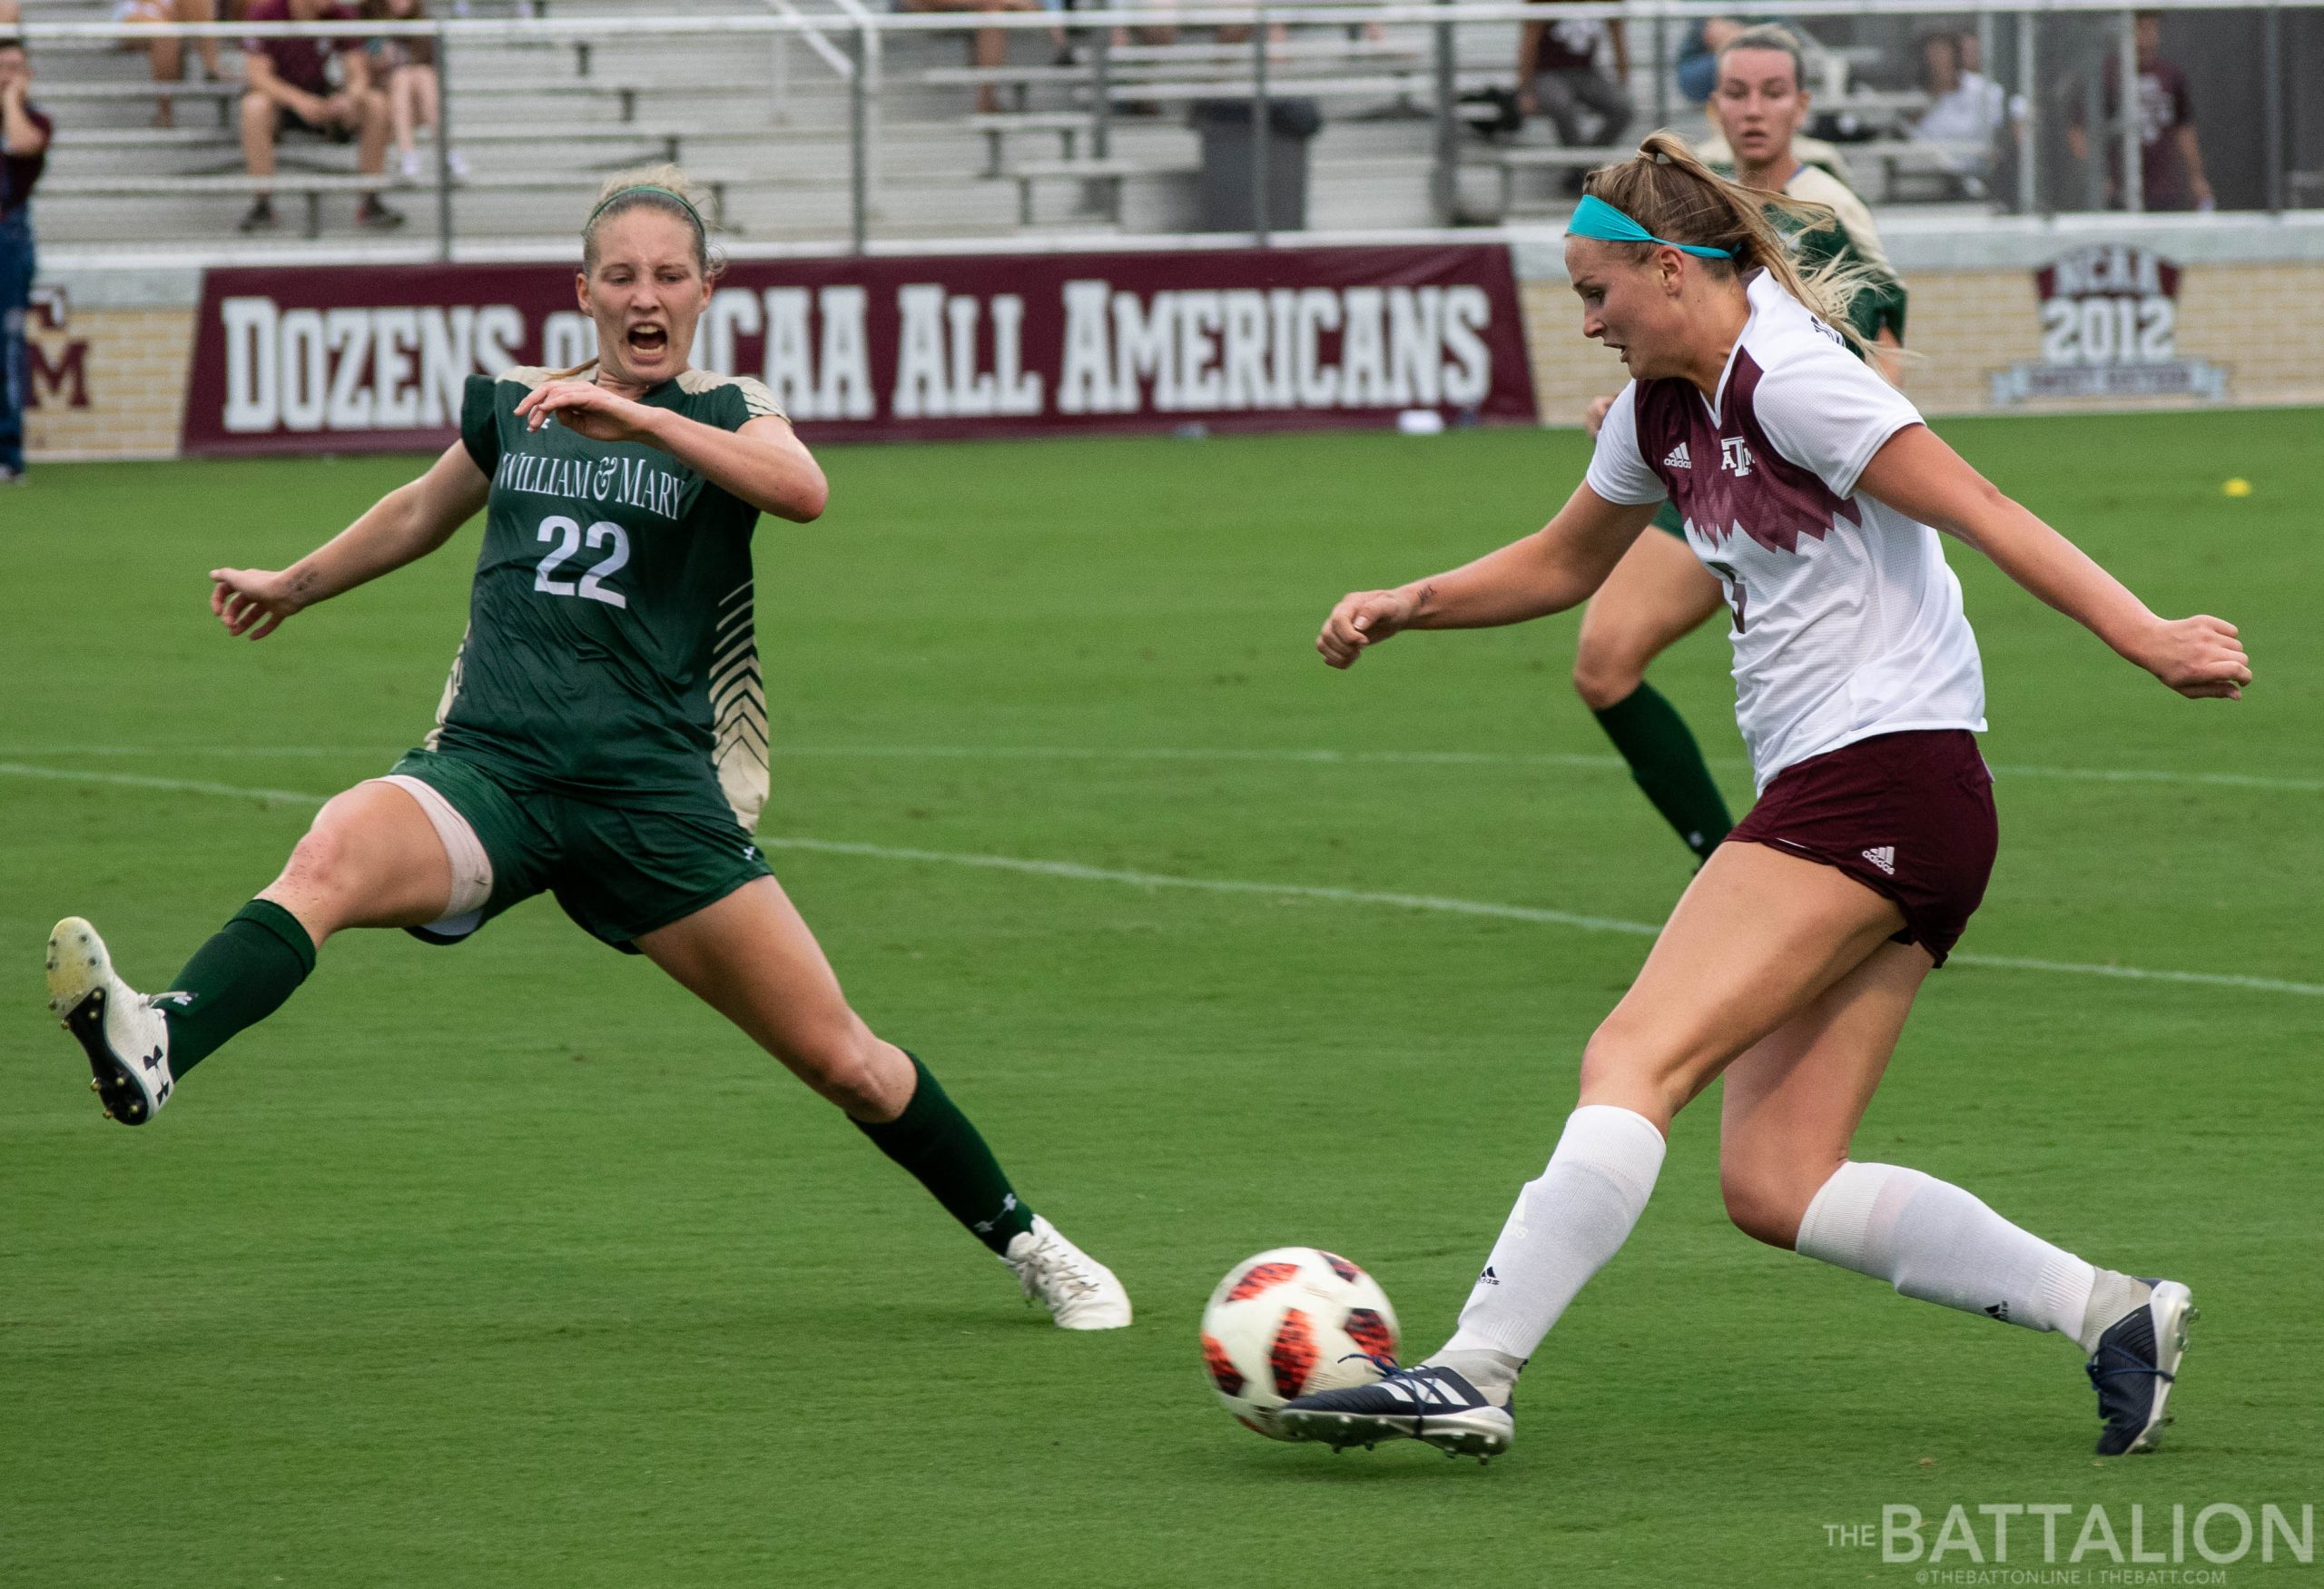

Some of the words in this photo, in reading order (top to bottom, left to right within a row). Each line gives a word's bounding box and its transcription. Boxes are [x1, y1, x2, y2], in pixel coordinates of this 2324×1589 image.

[892, 283, 1043, 419] ALL
[1057, 280, 1492, 414] AMERICANS
[2043, 298, 2175, 363] 2012
[534, 515, 630, 609] 22
[1862, 850, 1896, 875] adidas
